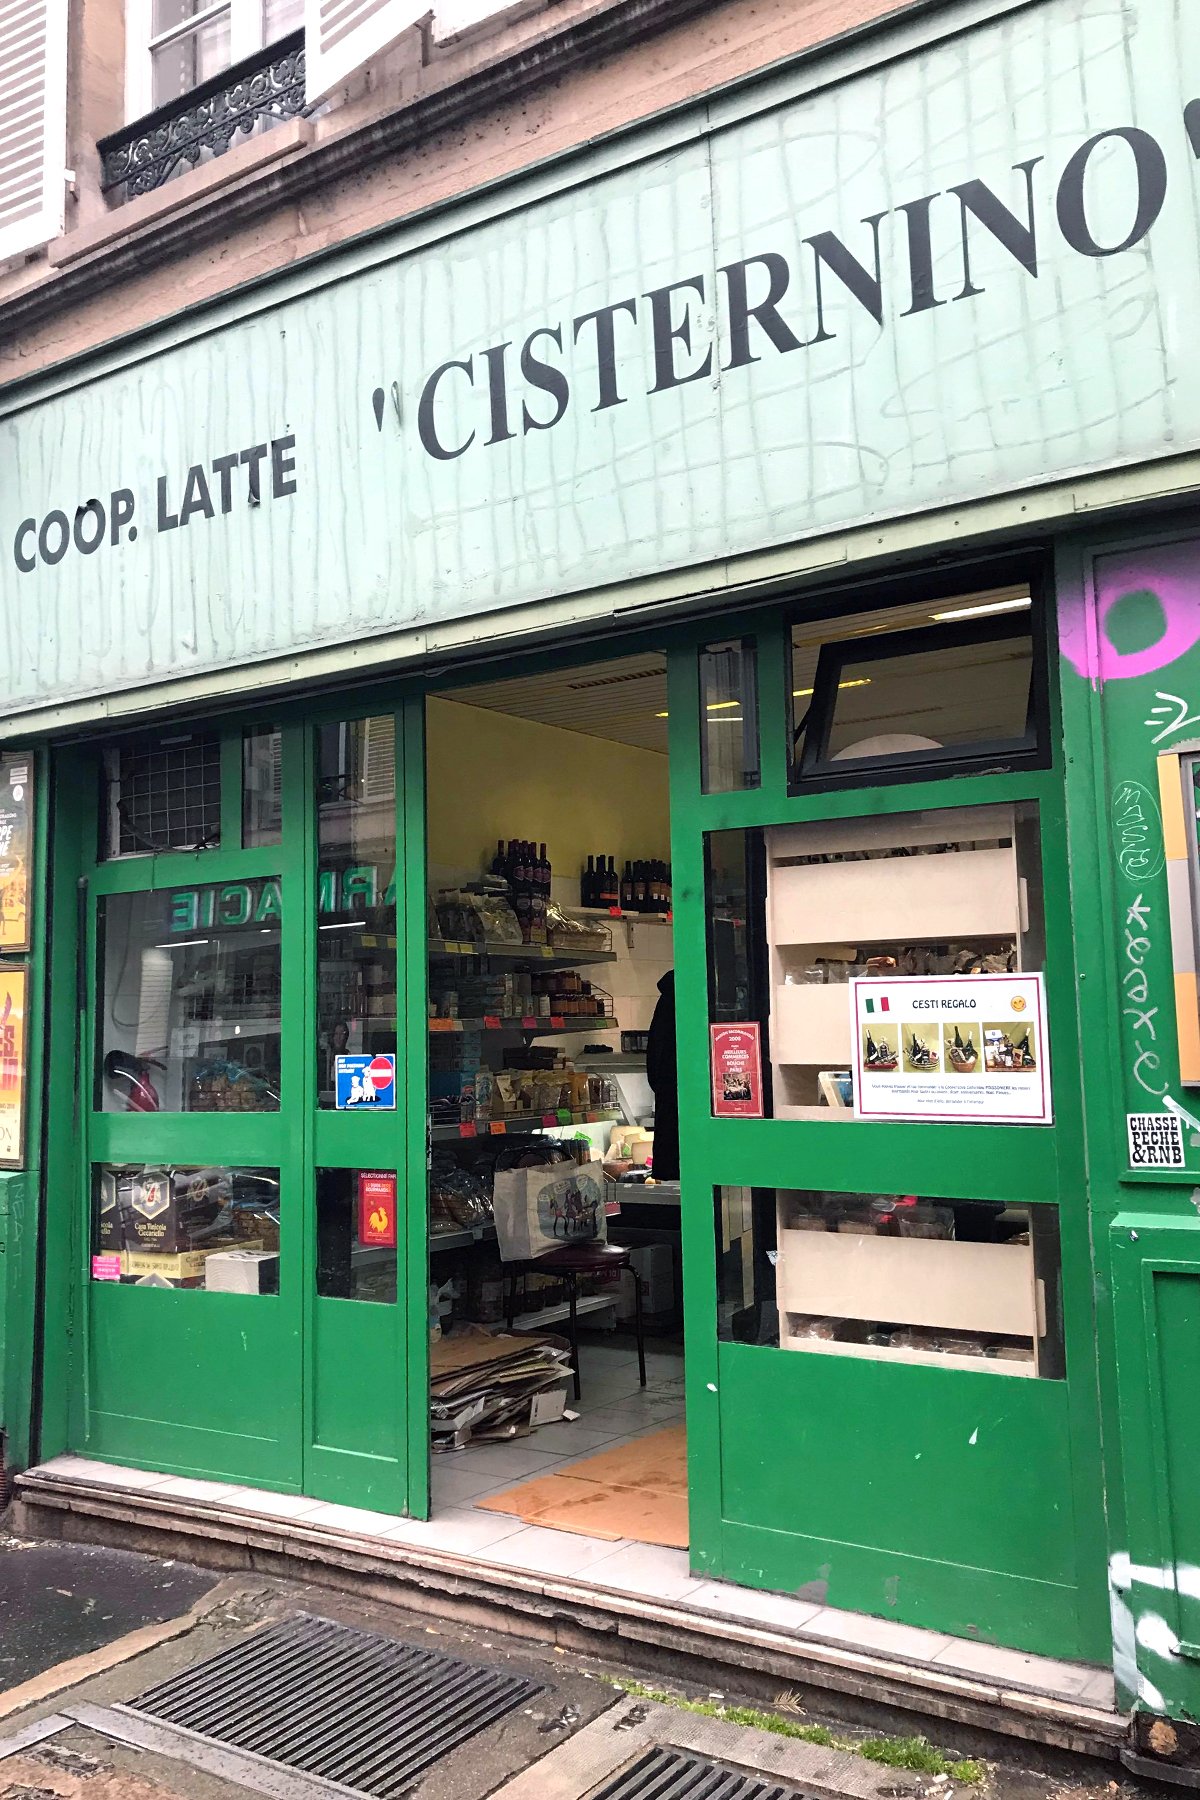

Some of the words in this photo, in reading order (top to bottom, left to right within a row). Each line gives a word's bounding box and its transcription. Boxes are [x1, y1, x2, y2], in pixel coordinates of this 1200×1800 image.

[14, 488, 137, 573] COOP.
[157, 434, 297, 533] LATTE
[912, 999, 939, 1009] CESTI
[941, 998, 977, 1009] REGALO
[1130, 1116, 1178, 1131] CHASSE
[1132, 1131, 1180, 1146] PECHE
[1132, 1144, 1182, 1164] &RNB
